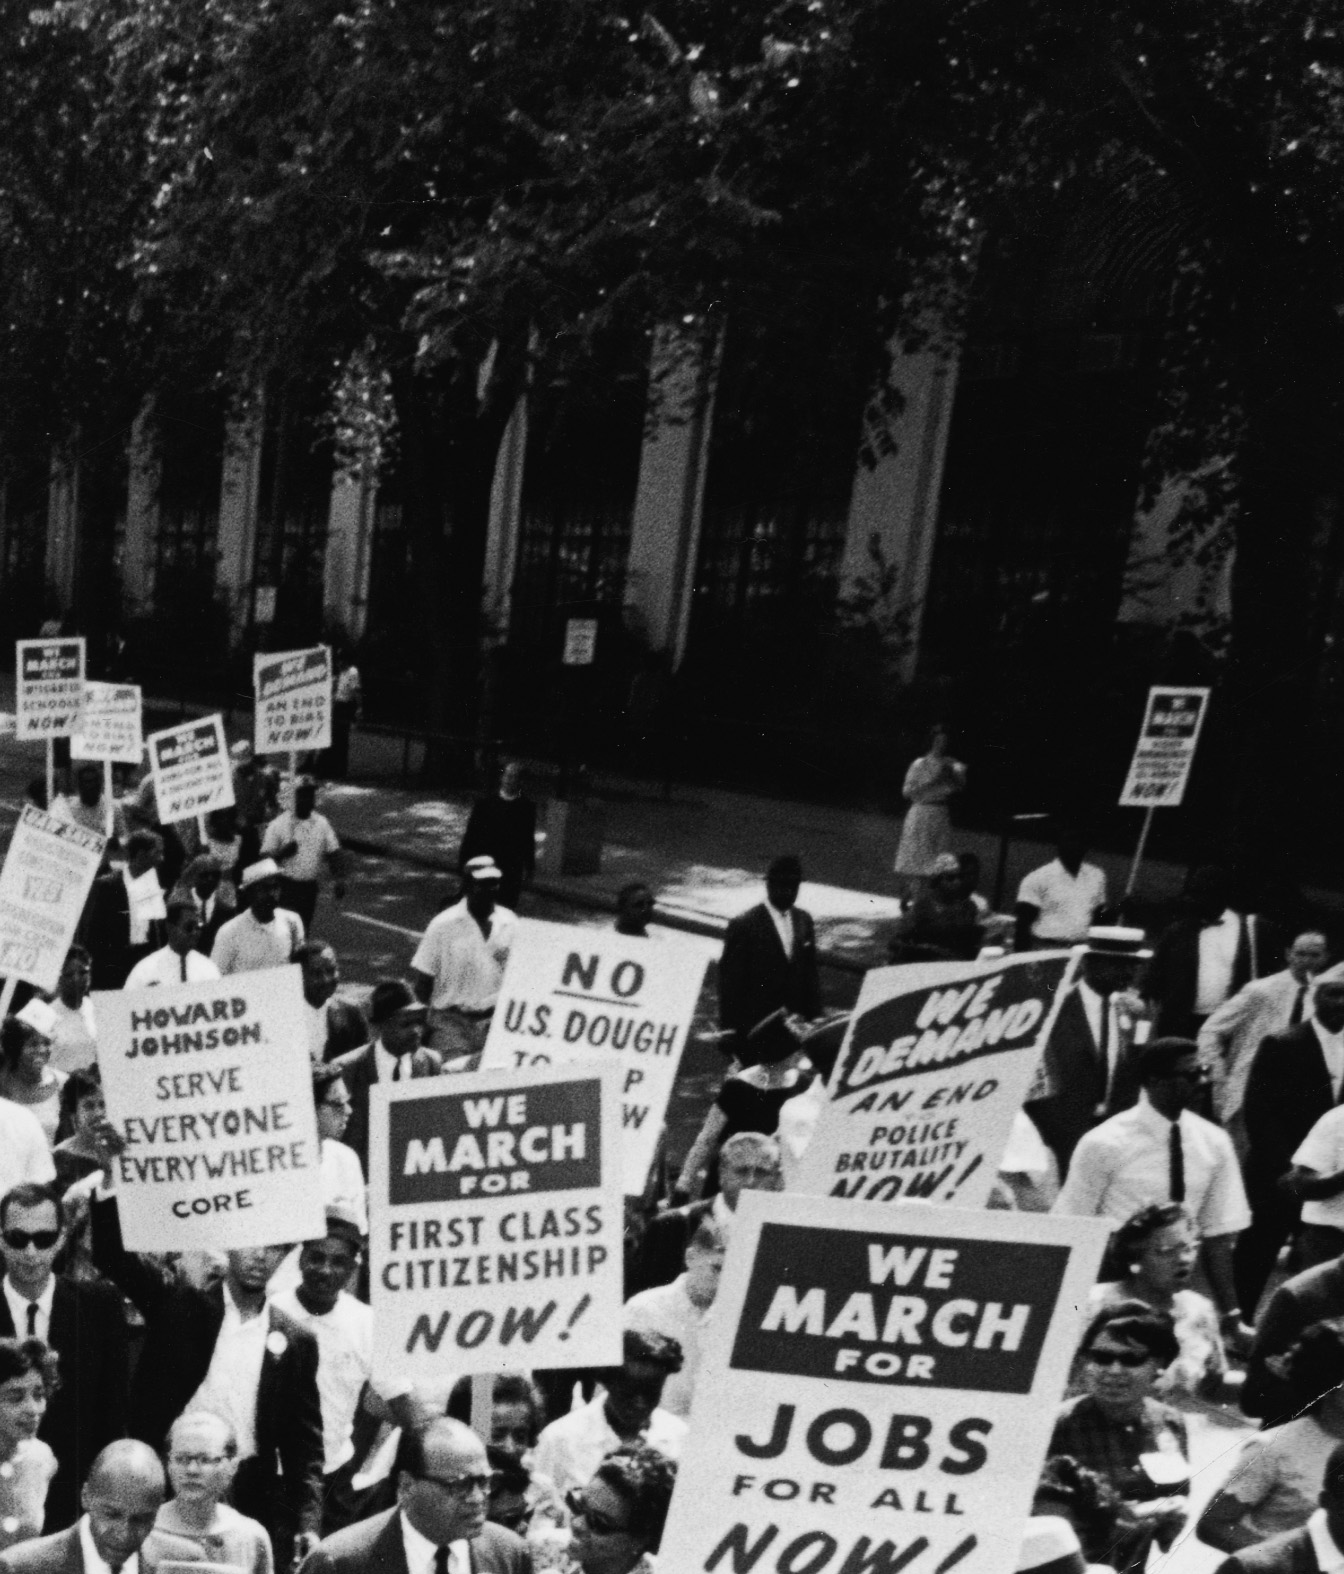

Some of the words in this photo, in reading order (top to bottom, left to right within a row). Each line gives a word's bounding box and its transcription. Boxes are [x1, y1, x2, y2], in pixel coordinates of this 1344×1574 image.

[561, 951, 646, 998] NO
[130, 996, 248, 1033] HOWARD
[915, 974, 1004, 1030] WE
[124, 1021, 262, 1060] JOHNSON
[503, 1000, 553, 1039] U.S.
[561, 1009, 680, 1057] DOUGH
[847, 998, 1043, 1087] DEMAND
[155, 1066, 244, 1102] SERVE
[848, 1090, 914, 1115] AN
[921, 1078, 1000, 1110] END
[123, 1101, 293, 1146] EVERYONE
[463, 1093, 528, 1129] WE
[869, 1118, 959, 1147] POLICE
[118, 1140, 309, 1184] EVERYWHERE
[403, 1122, 588, 1176] MARCH
[834, 1140, 969, 1174] BRUTALITY
[459, 1170, 531, 1196] FOR
[829, 1153, 984, 1201] NOW!
[171, 1188, 254, 1219] CORE
[389, 1215, 485, 1251] FIRST
[498, 1204, 603, 1241] CLASS
[381, 1243, 608, 1292] CITIZENSHIP
[867, 1243, 960, 1291] WE
[405, 1293, 592, 1355] NOW!
[759, 1285, 1031, 1352] MARCH
[833, 1348, 937, 1380] FOR
[734, 1402, 994, 1478] JOBS
[731, 1474, 837, 1505] FOR
[870, 1486, 966, 1516] ALL
